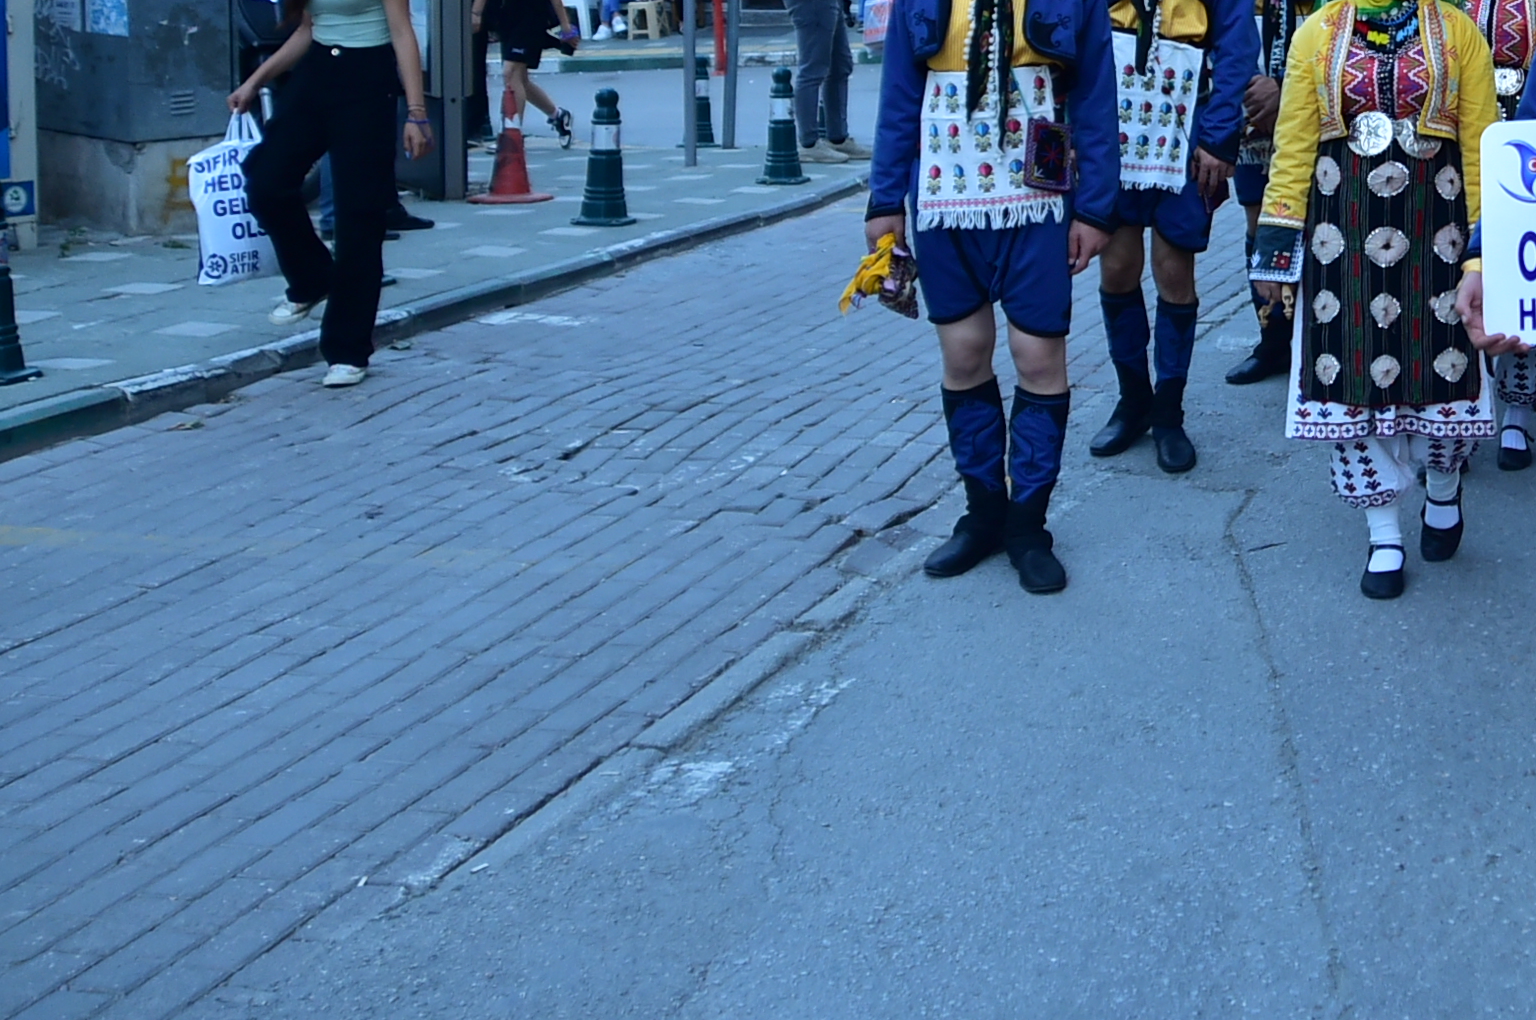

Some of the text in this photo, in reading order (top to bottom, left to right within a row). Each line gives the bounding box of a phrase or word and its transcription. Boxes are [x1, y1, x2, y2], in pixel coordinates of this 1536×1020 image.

[194, 148, 240, 174] SIFIR
[204, 173, 243, 194] HED
[213, 197, 251, 217] GEL
[229, 250, 260, 264] SIFIR
[230, 261, 260, 275] ATIK
